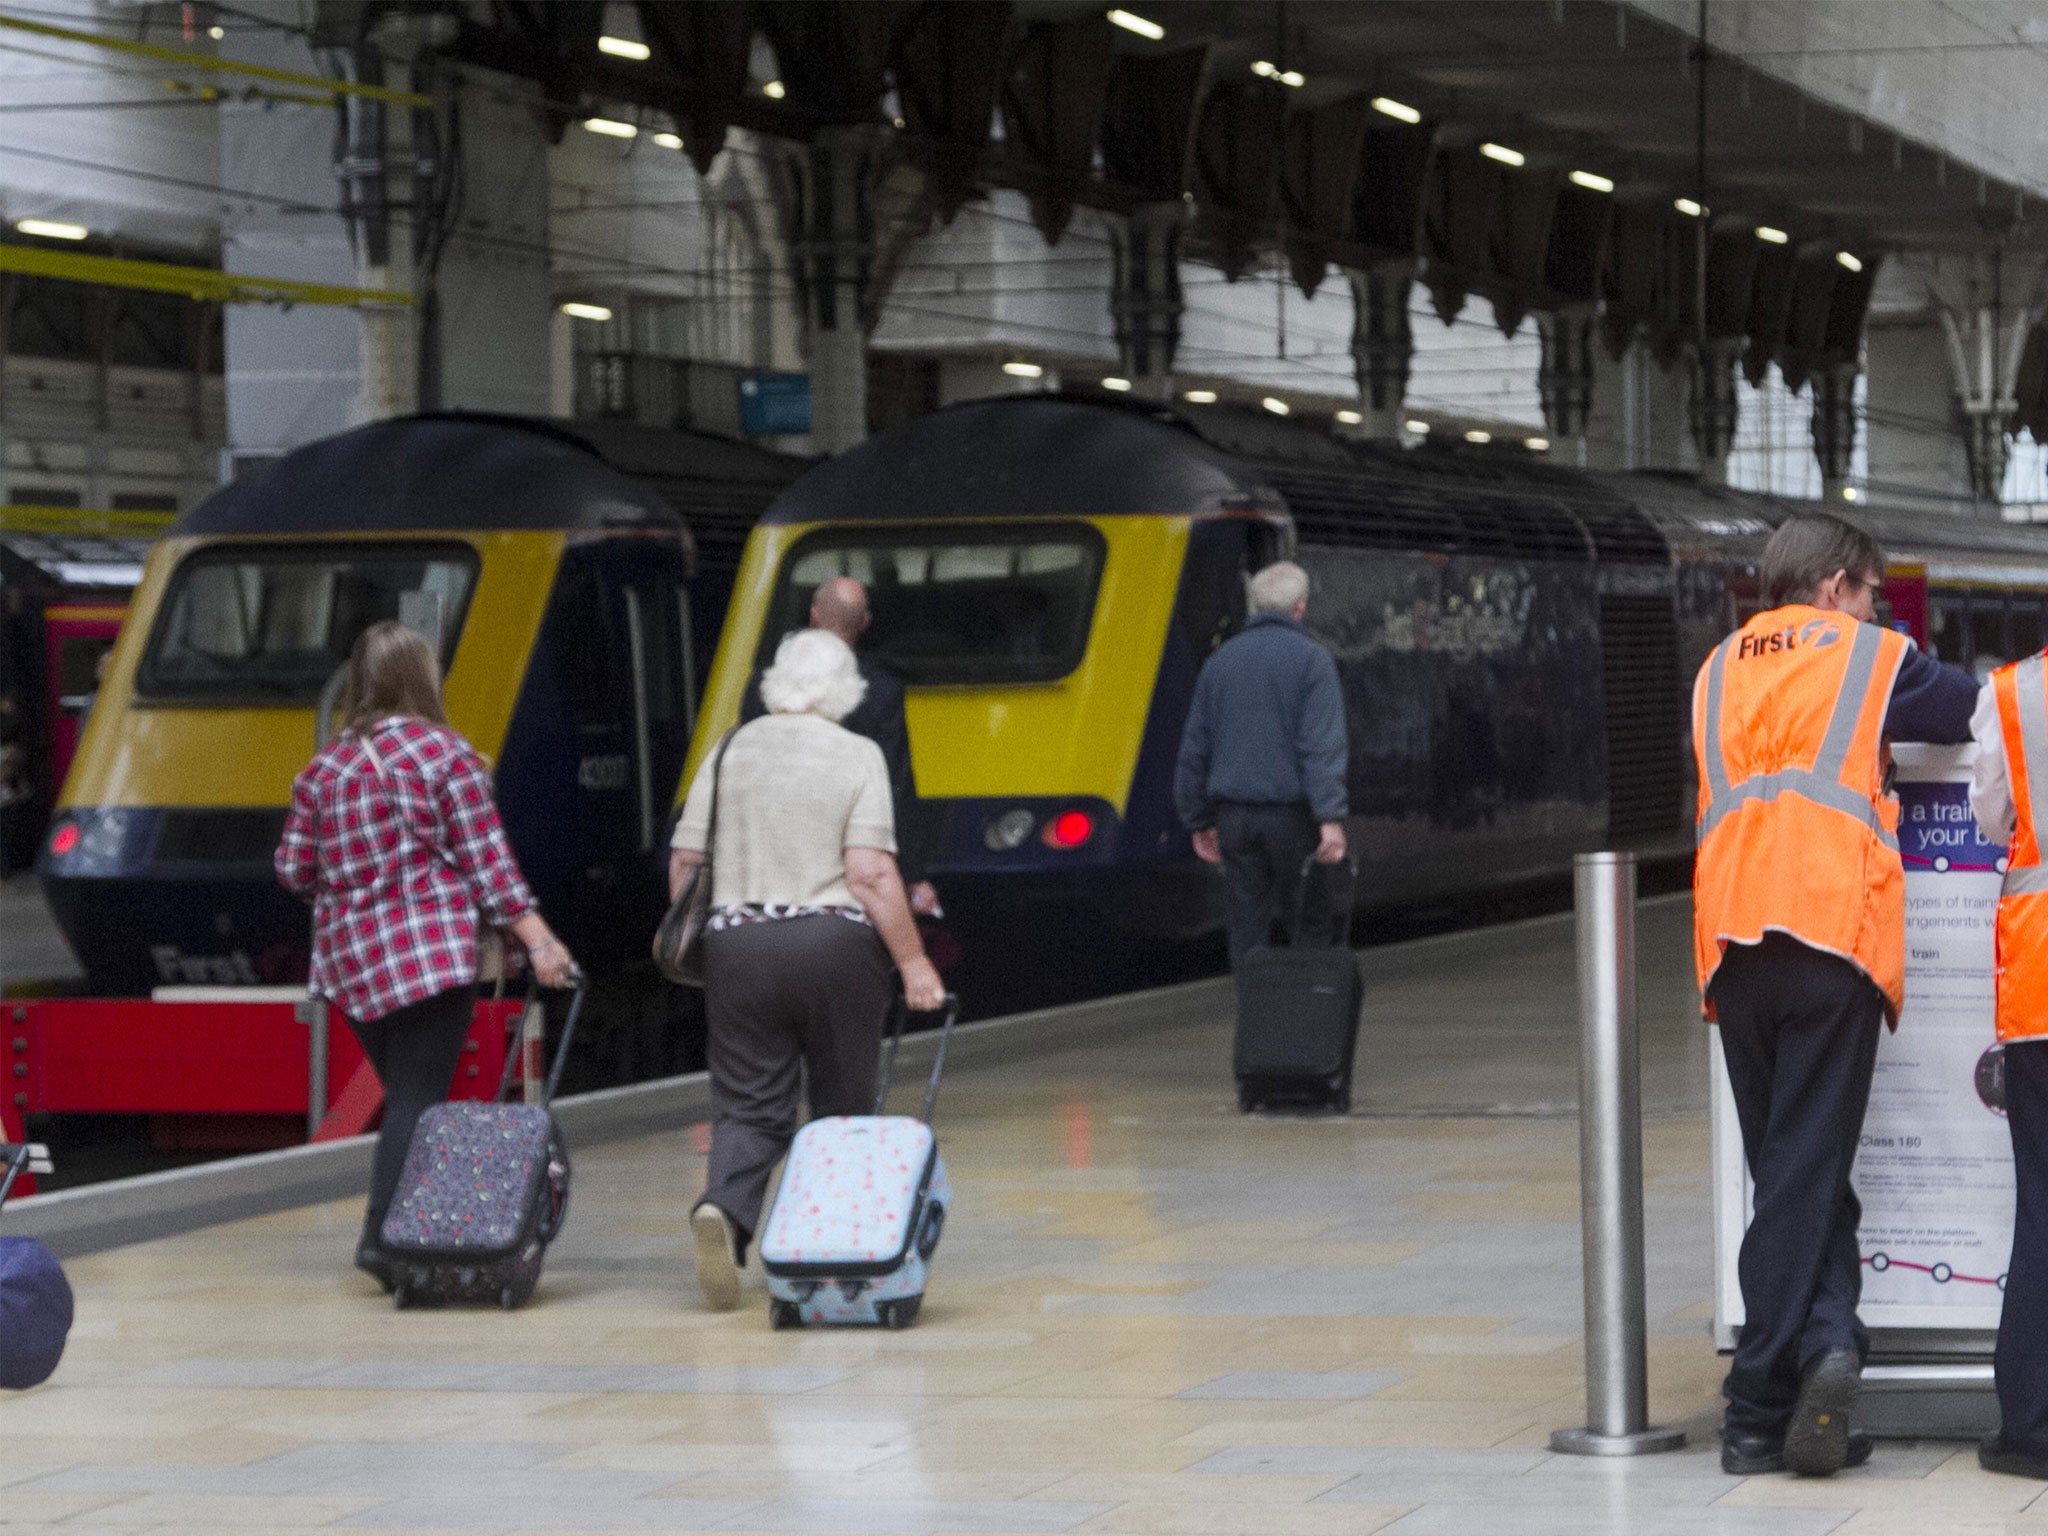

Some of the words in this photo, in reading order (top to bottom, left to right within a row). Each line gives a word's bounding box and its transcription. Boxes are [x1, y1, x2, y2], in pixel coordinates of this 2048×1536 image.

[1738, 625, 1796, 660] First
[1912, 804, 1926, 823] a
[1917, 827, 1968, 850] your
[1946, 896, 1959, 909] of
[1906, 917, 1981, 930] angements
[1912, 948, 1940, 960] train
[1860, 1135, 1895, 1148] Class
